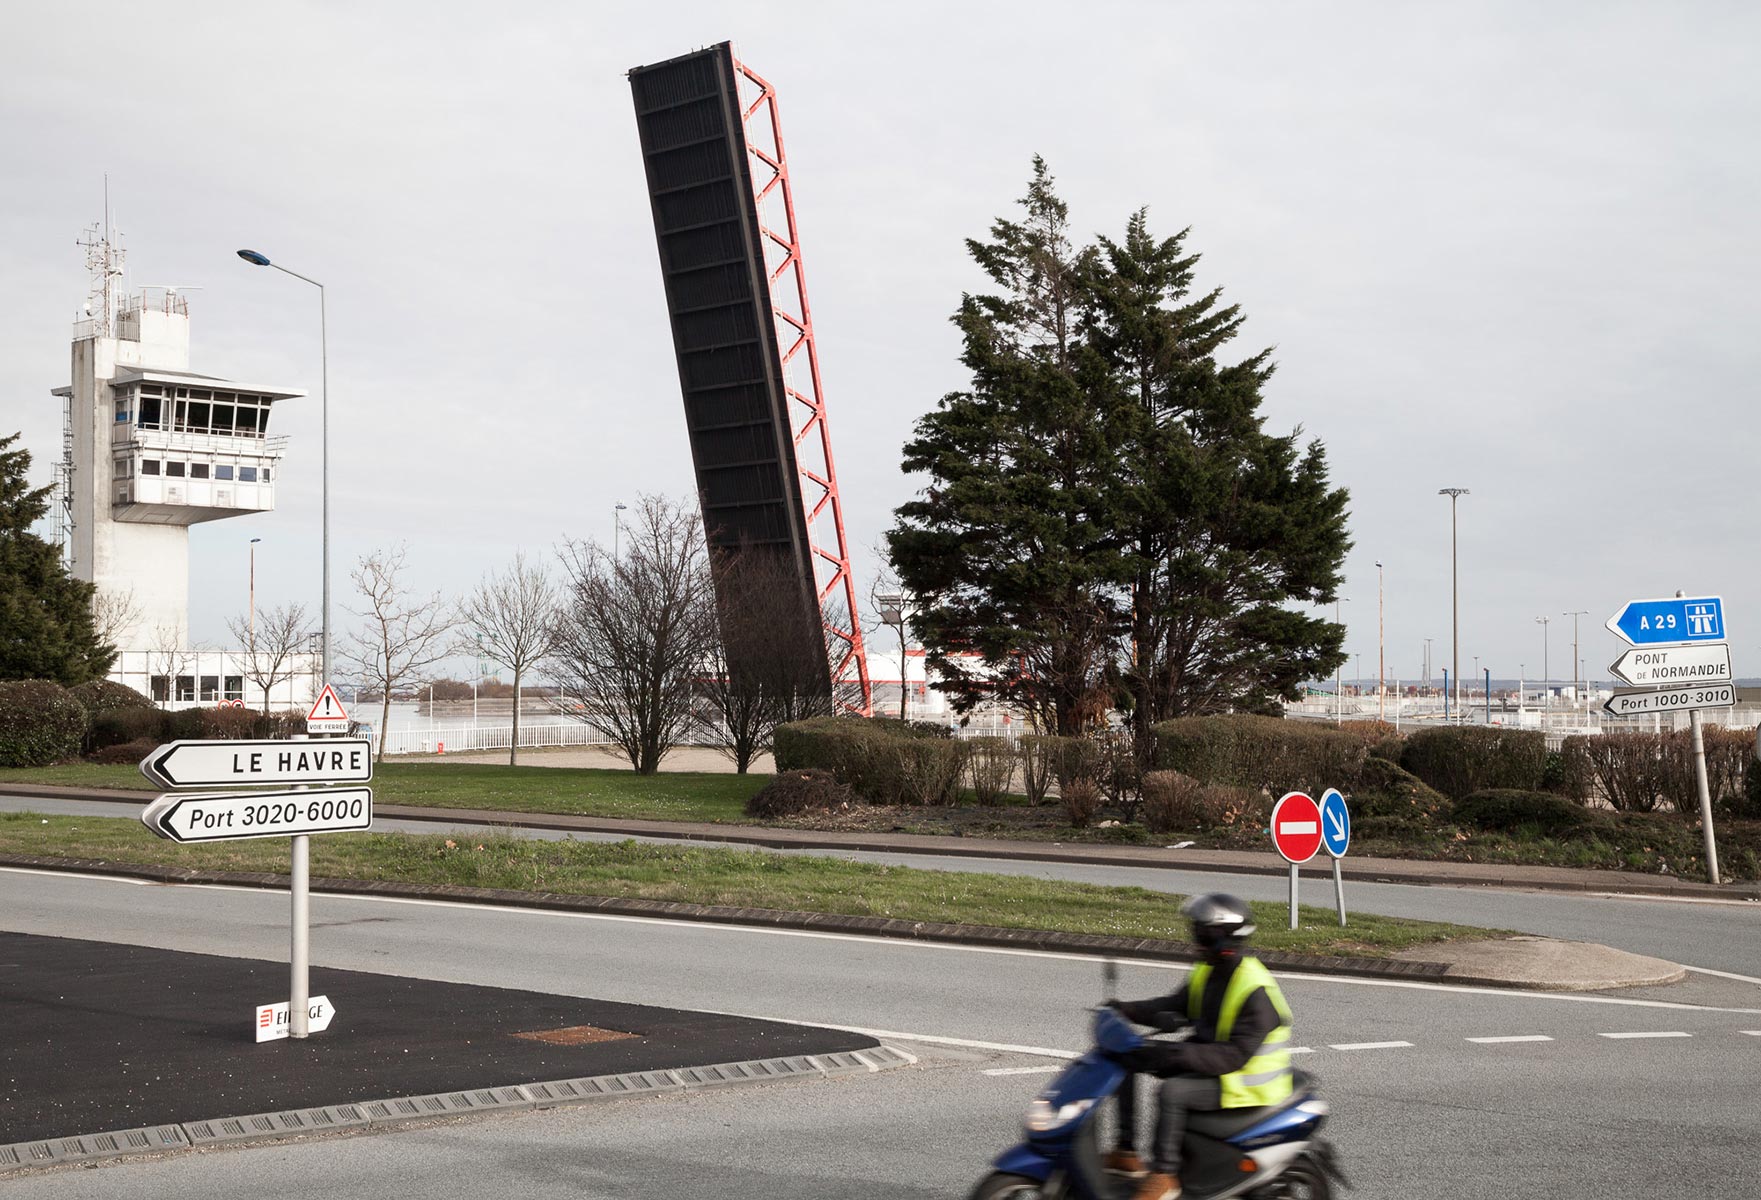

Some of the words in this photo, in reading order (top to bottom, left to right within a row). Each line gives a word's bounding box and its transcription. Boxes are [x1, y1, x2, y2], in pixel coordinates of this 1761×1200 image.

[1640, 615, 1650, 630] A
[1655, 614, 1676, 629] 29
[1635, 653, 1668, 665] PONT
[1636, 672, 1646, 680] DE
[1652, 664, 1726, 679] NORMANDIE
[1621, 699, 1648, 710] Port
[1655, 690, 1729, 706] 1000-3010
[233, 753, 262, 773] LE
[278, 751, 361, 772] HAVRE
[190, 809, 234, 829] Port
[242, 799, 362, 826] 3020-6000
[277, 1005, 323, 1025] EIGE
